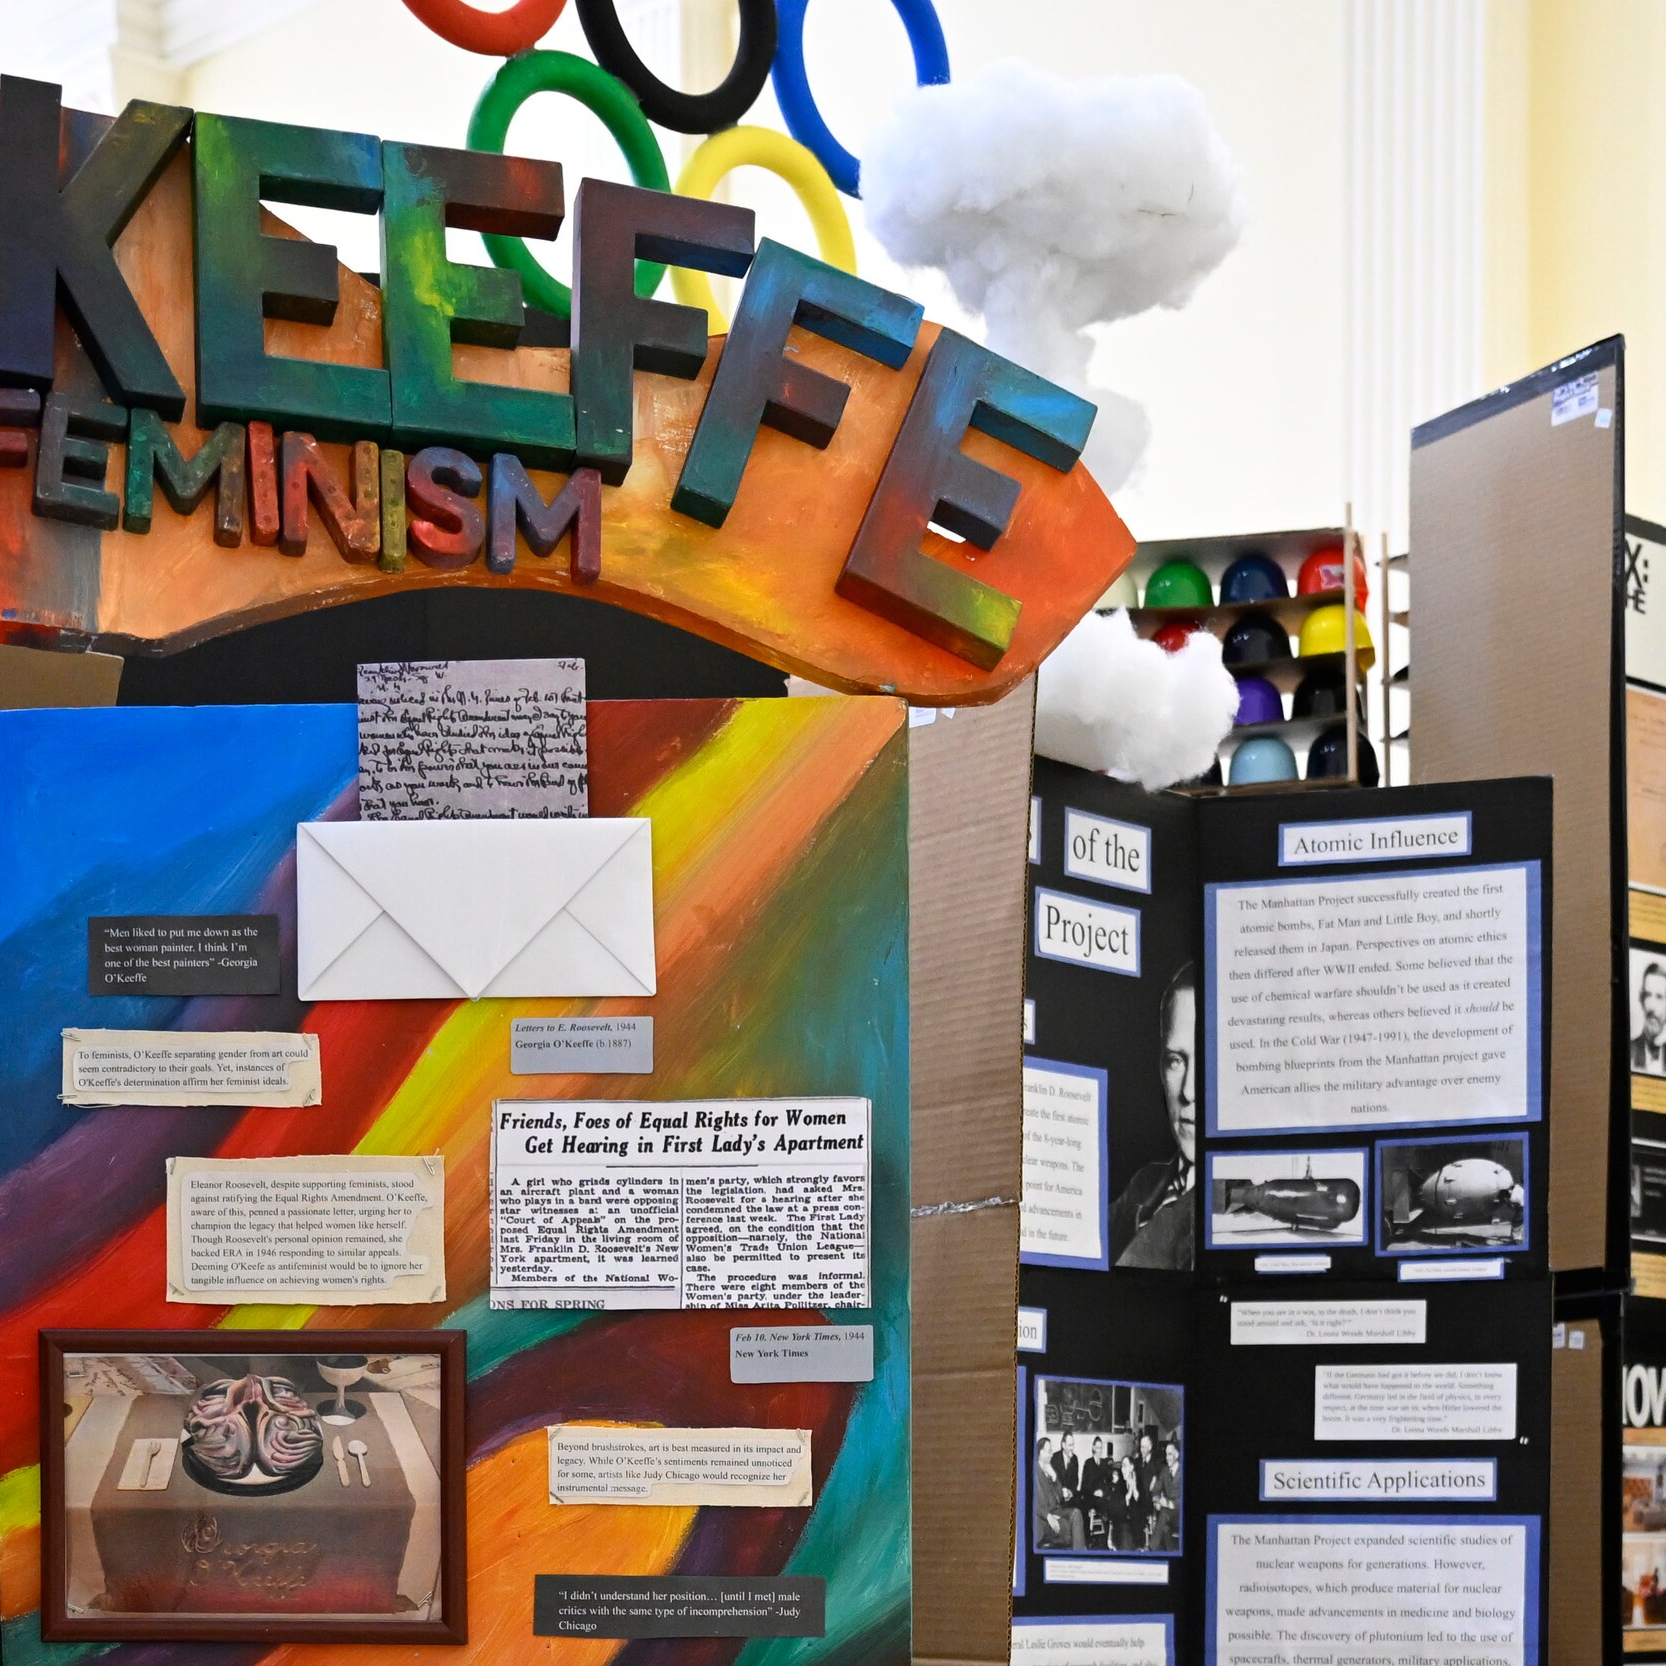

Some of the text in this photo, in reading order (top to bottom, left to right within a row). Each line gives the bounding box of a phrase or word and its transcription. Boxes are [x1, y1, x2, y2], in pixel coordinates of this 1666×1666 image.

[1294, 827, 1459, 855] Atomic Influence
[1073, 828, 1140, 872] of the
[1237, 882, 1503, 912] The Manhattan Project successfully created the first
[132, 927, 155, 937] liked
[157, 928, 167, 937] to
[168, 928, 185, 940] put
[186, 929, 202, 937] me
[202, 927, 230, 937] down
[230, 929, 242, 937] as
[242, 926, 258, 937] the
[1045, 905, 1129, 958] Project
[104, 943, 123, 953] best
[124, 944, 159, 952] woman
[159, 942, 196, 954] painter.
[197, 942, 202, 953] I
[203, 942, 229, 952] think
[104, 960, 121, 968] one
[123, 957, 134, 968] of
[135, 957, 150, 967] the
[150, 957, 171, 968] best
[216, 957, 258, 969] -Georgia
[77, 1051, 90, 1060] To
[173, 1049, 216, 1061] separating
[217, 1049, 247, 1061] gender
[249, 1049, 270, 1059] from
[271, 1050, 283, 1058] art
[285, 1049, 309, 1059] could
[78, 1066, 99, 1074] seem
[101, 1064, 156, 1075] contradictory
[158, 1064, 167, 1073] to
[168, 1063, 187, 1073] their
[235, 1063, 274, 1072] instances
[275, 1062, 286, 1072] of
[123, 1077, 180, 1087] determination
[182, 1076, 208, 1087] affirm
[209, 1077, 223, 1086] her
[226, 1076, 260, 1086] feminist
[500, 1108, 847, 1133] Friends, Foes of Equal Rights for Women
[524, 1135, 554, 1154] Get
[560, 1134, 629, 1158] Hearing
[637, 1141, 654, 1154] in
[661, 1134, 703, 1154] First
[773, 1133, 865, 1154] Apartment
[735, 1333, 752, 1342] Feb
[768, 1332, 789, 1342] New
[791, 1332, 811, 1342] York
[844, 1331, 865, 1341] 1944
[735, 1348, 808, 1359] New York Times
[1274, 1470, 1486, 1494] Scientific Applications
